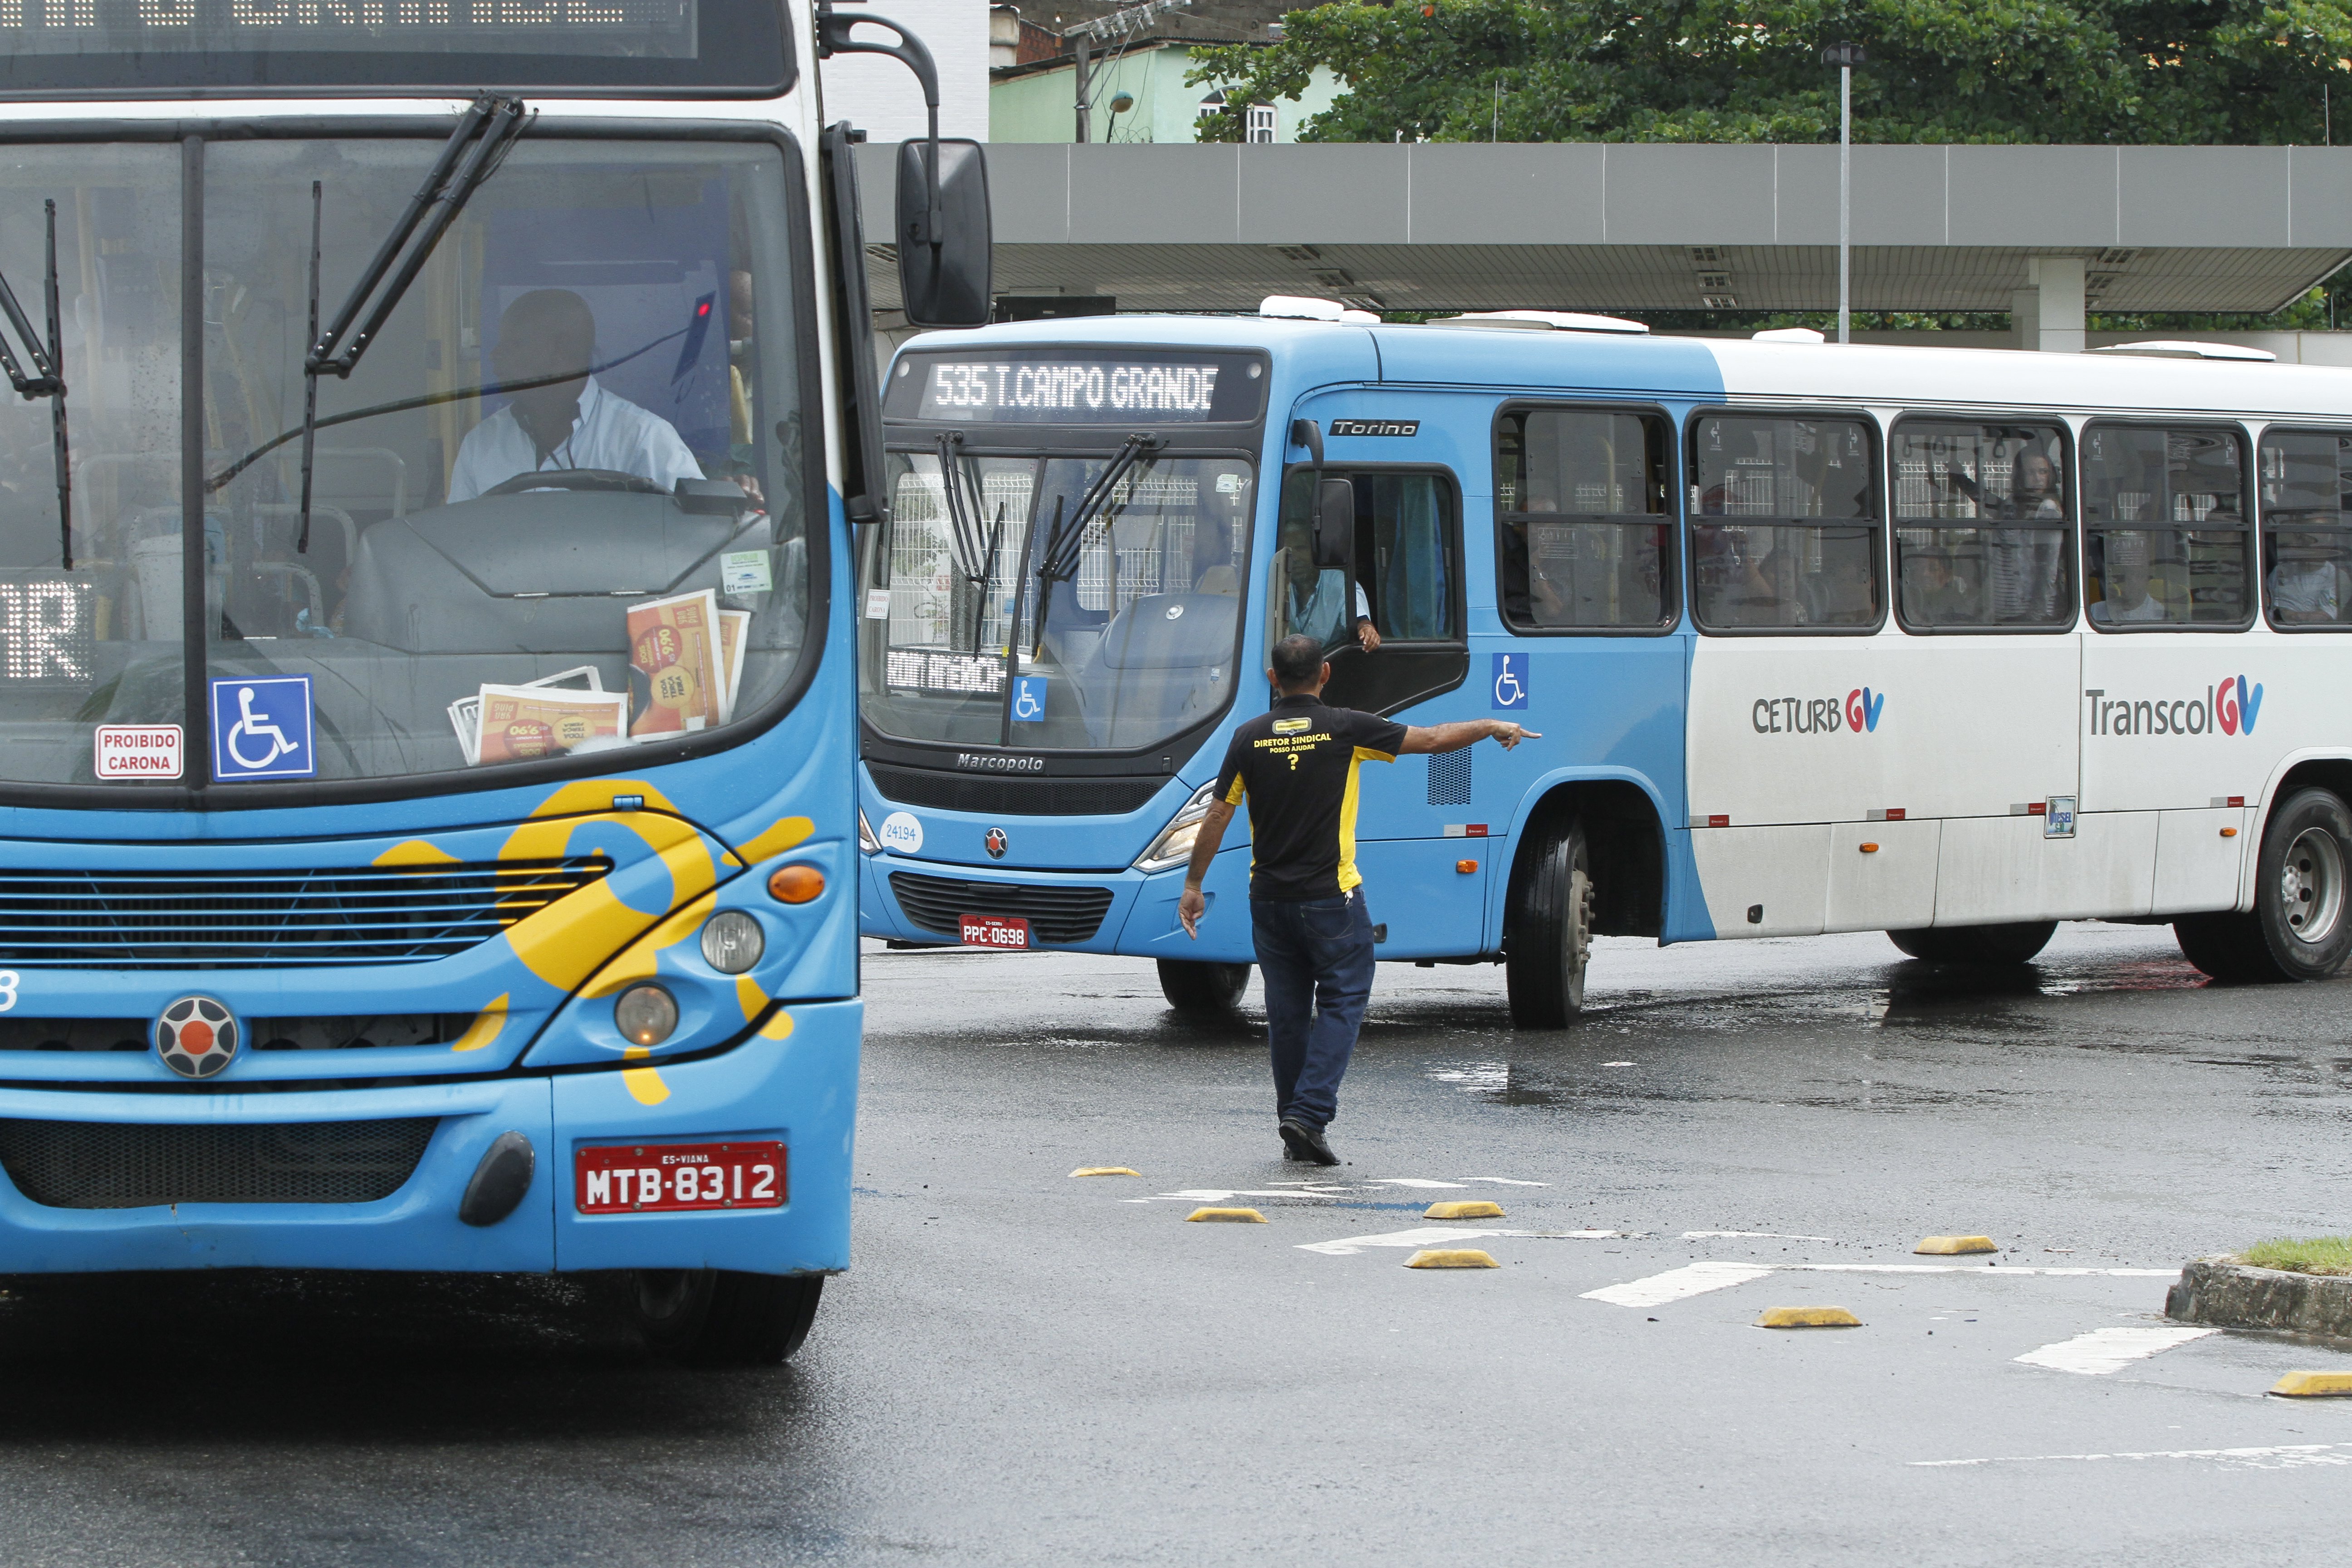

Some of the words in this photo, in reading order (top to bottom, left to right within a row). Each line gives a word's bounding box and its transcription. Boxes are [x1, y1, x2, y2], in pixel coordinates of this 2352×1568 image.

[936, 365, 987, 406] 535
[1111, 367, 1219, 410] GRANDE
[1335, 421, 1416, 435] Torino
[659, 628, 675, 656] 9,90
[660, 679, 669, 700] TODA
[1752, 697, 1842, 734] CETURB
[1845, 686, 1884, 733] GV
[2085, 685, 2213, 735] Transcol
[2216, 674, 2264, 736] GV
[510, 724, 540, 735] 9,90
[104, 734, 175, 748] PROIBIDO
[1254, 738, 1289, 748] DIRETOR
[1292, 733, 1332, 745] SINDICAL
[1291, 744, 1315, 752] AJUDAR
[108, 756, 170, 770] CARONA
[957, 753, 1043, 771] Marcopolo
[1287, 753, 1299, 770] ?
[886, 824, 916, 842] 24194
[662, 1154, 709, 1165] ES-VIANA
